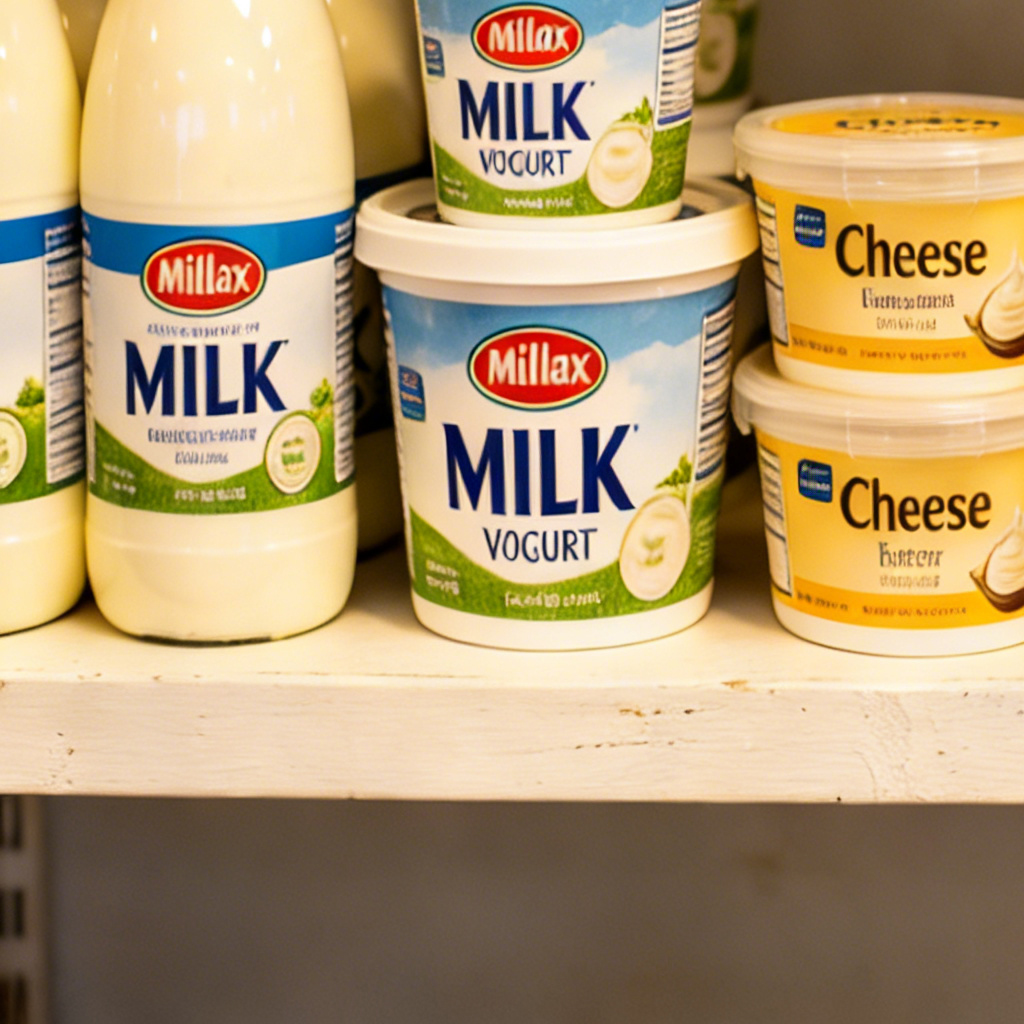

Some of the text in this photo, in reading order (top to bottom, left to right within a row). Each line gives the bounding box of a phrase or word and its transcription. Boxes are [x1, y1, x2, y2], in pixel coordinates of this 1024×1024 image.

[457, 79, 591, 141] MILK
[157, 253, 252, 295] Millax
[836, 224, 987, 278] Cheese
[124, 339, 288, 417] MILK
[487, 342, 592, 386] Millax
[442, 422, 636, 516] MILK
[840, 477, 992, 532] Cheese
[482, 527, 598, 564] VOGURT
